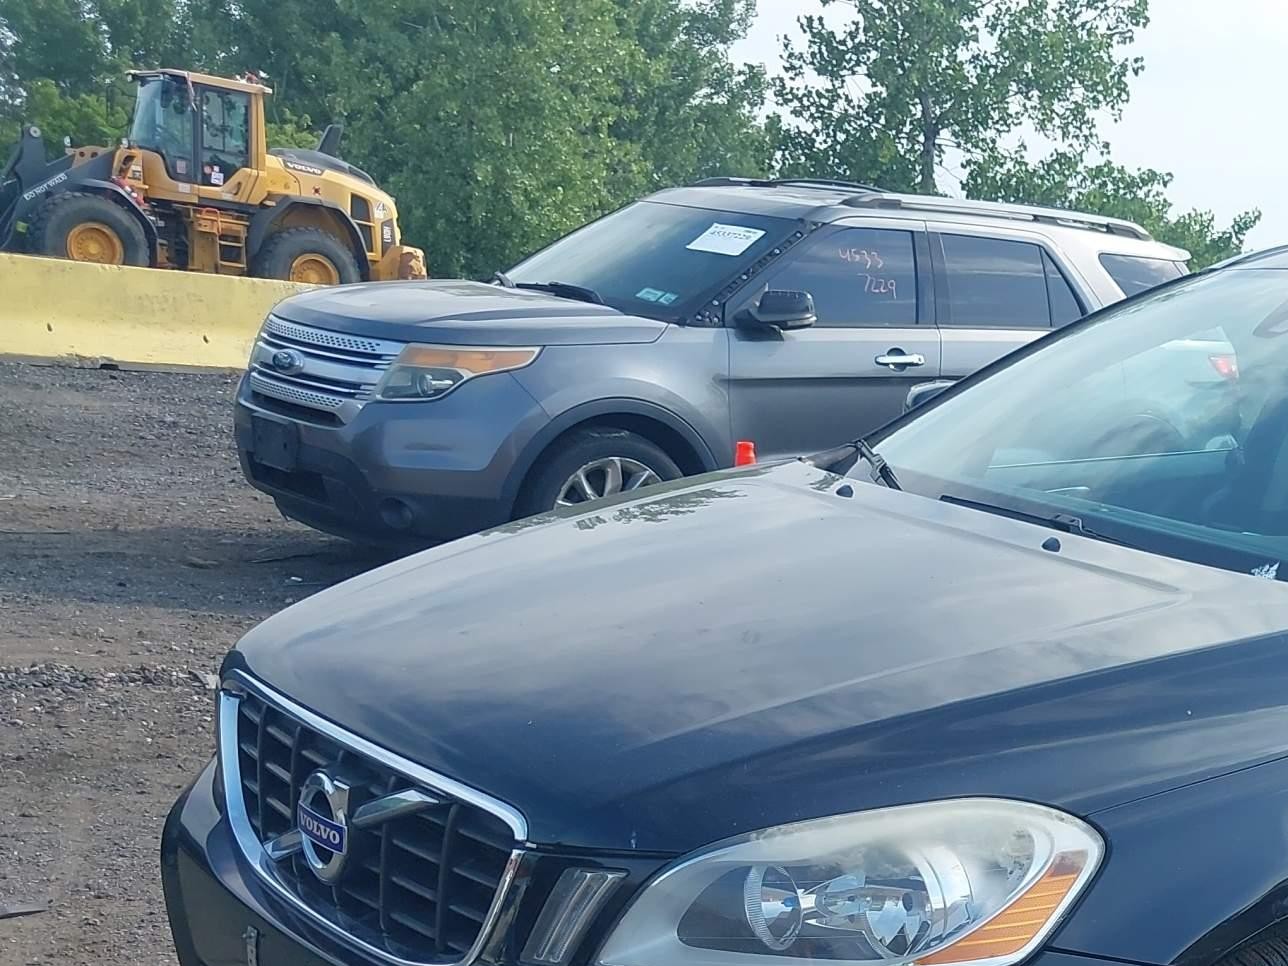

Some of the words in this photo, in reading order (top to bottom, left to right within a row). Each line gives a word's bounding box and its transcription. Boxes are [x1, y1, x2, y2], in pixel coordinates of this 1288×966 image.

[286, 161, 322, 175] VOLVO
[839, 247, 884, 270] 4533
[857, 273, 897, 300] 7229
[300, 810, 341, 845] VOLVO
